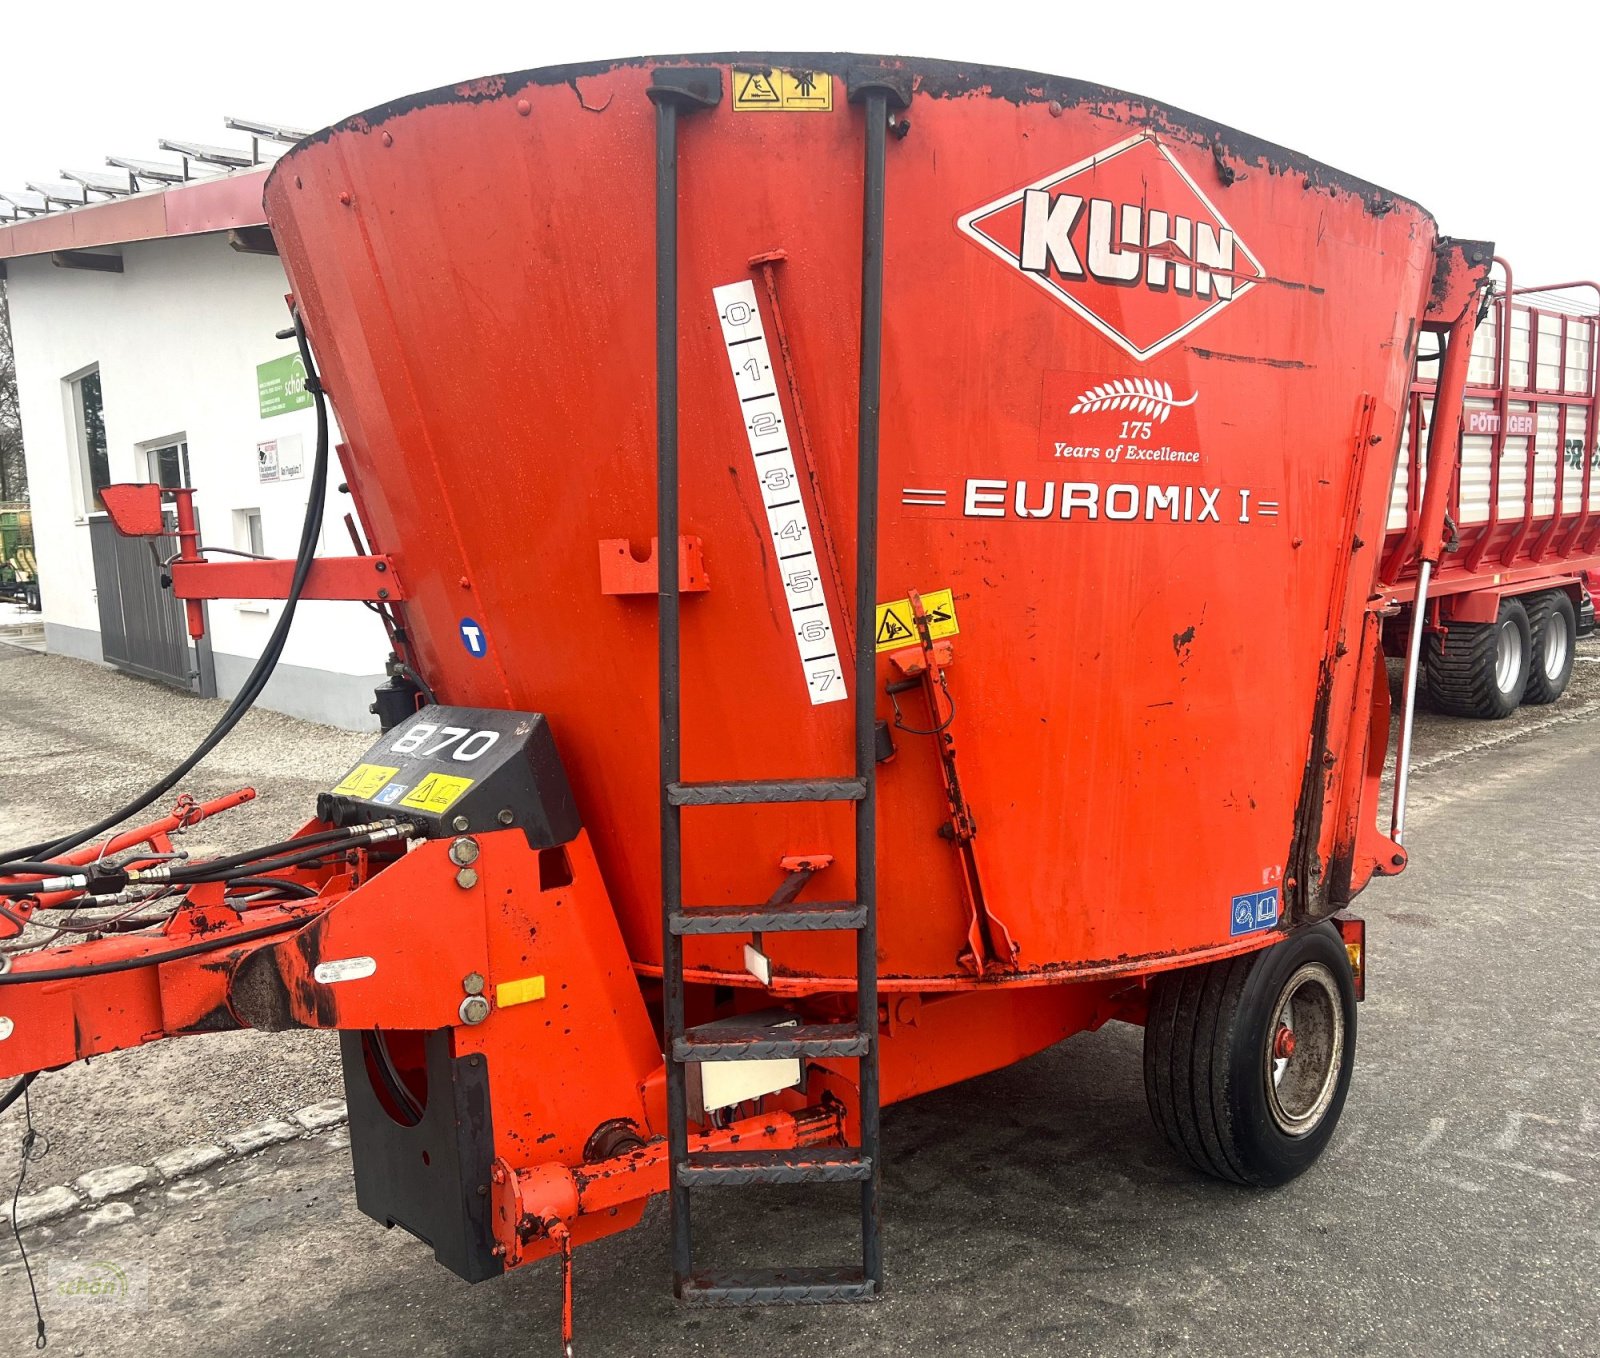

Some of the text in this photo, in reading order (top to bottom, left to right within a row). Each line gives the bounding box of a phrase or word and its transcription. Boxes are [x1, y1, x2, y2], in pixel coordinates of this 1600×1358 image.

[1021, 188, 1234, 302] KUHN
[725, 301, 753, 327] 0
[742, 358, 761, 382] 1
[284, 372, 306, 396] schön
[751, 411, 779, 438] 2
[1118, 420, 1152, 440] 175
[1470, 411, 1533, 433] PÖTTGER
[1054, 442, 1200, 463] Years of Excellence
[764, 467, 791, 491] 3
[963, 478, 1250, 523] EUROMIX I
[779, 519, 803, 542] 4
[788, 569, 814, 594] 5
[461, 626, 481, 652] T
[800, 619, 827, 642] 6
[812, 669, 836, 692] 7
[390, 724, 500, 762] 870
